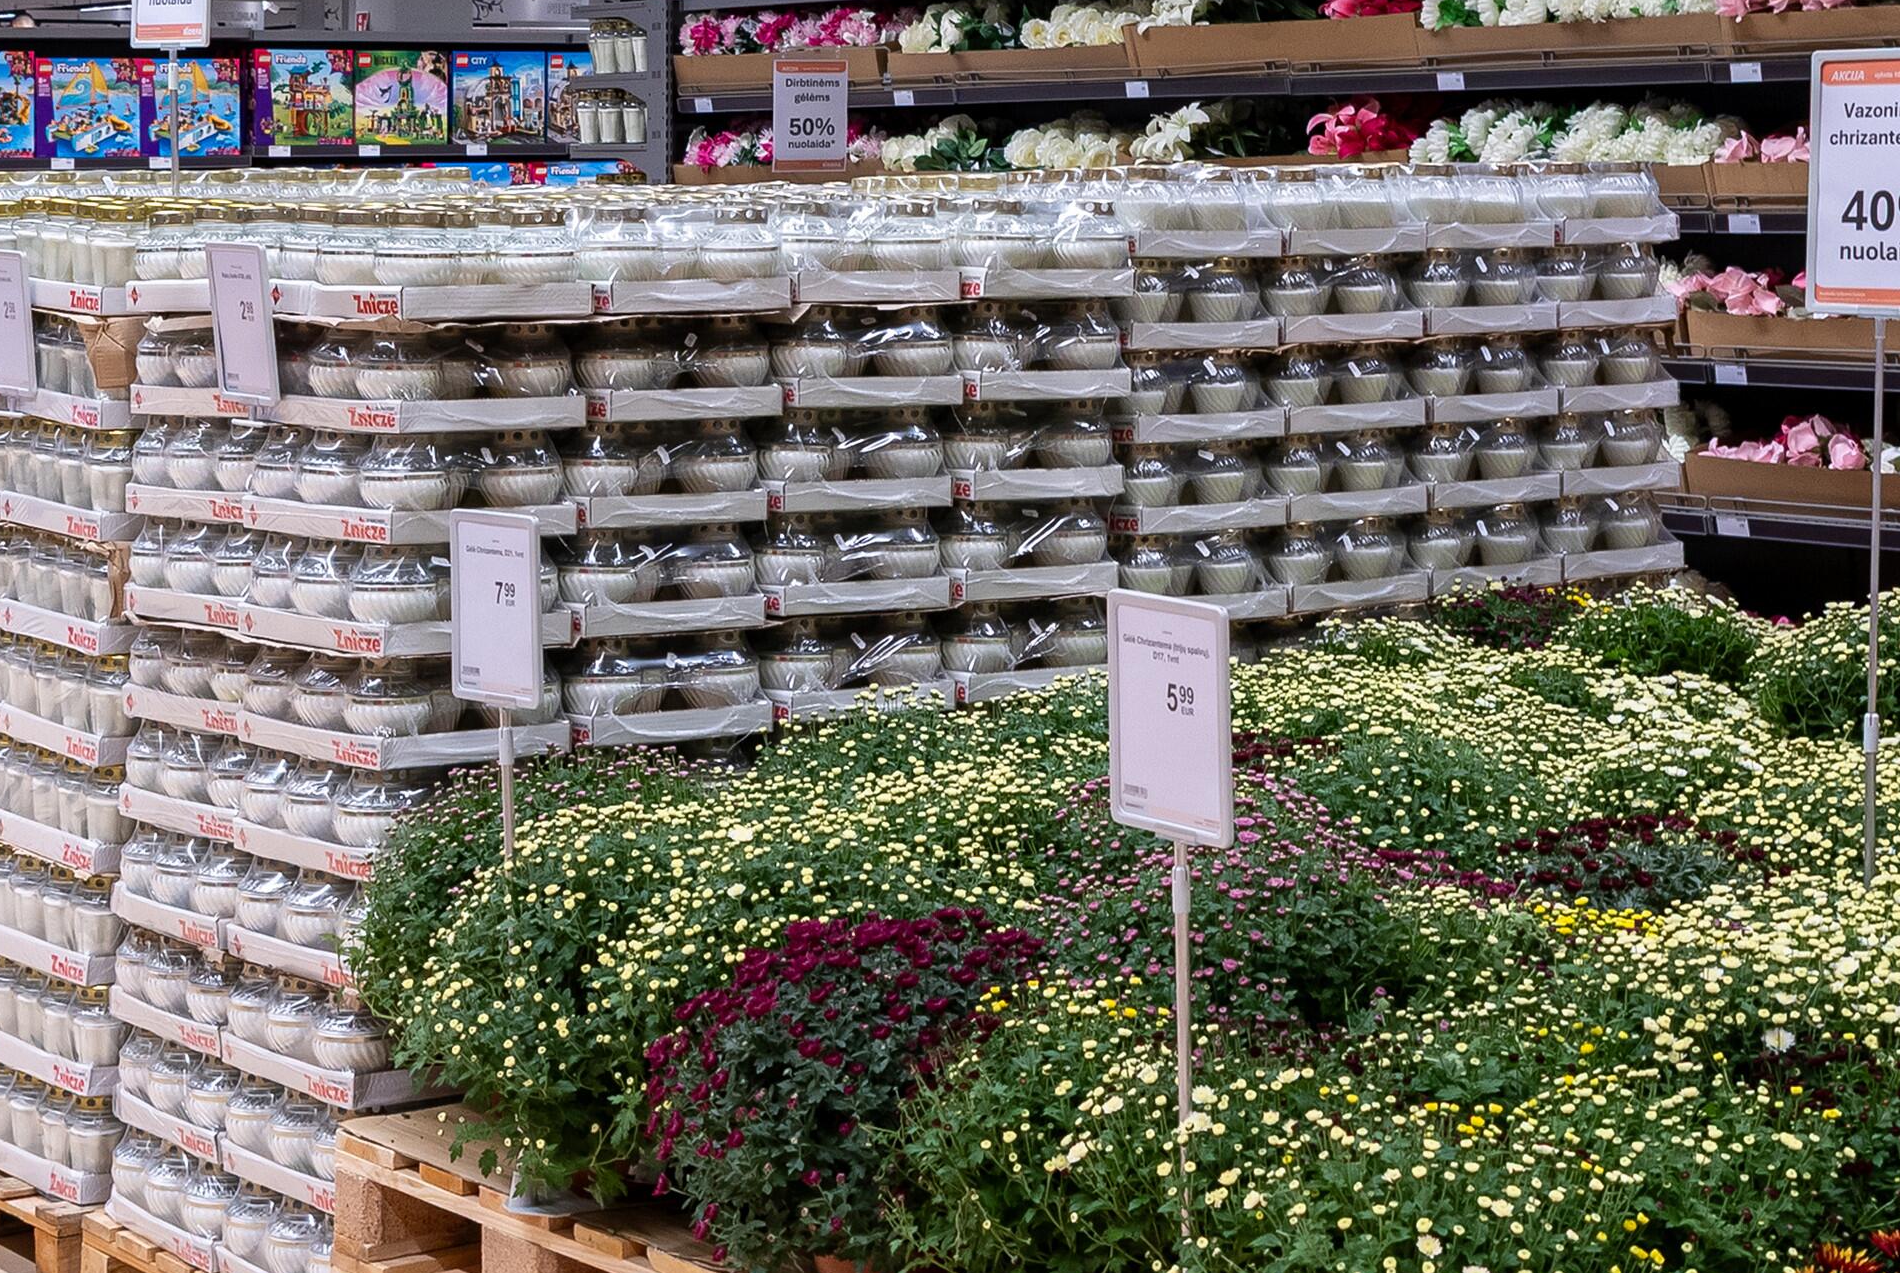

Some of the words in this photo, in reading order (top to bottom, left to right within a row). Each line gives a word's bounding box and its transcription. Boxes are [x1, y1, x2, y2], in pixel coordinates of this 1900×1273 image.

[56, 62, 91, 74] Friends
[275, 53, 308, 65] Friends
[471, 56, 488, 65] CITY
[785, 78, 840, 88] Dirbtinėms
[1831, 70, 1866, 81] AKCIJA
[794, 92, 830, 104] gėlėms
[789, 117, 836, 137] 50%
[550, 165, 580, 176] Friends
[70, 290, 99, 311] Znicze
[352, 294, 398, 315] Znicze
[349, 407, 395, 428] Znicze
[211, 499, 243, 520] Znicz
[68, 516, 97, 539] Znicze
[342, 519, 386, 540] Znicze
[495, 581, 504, 604] 7
[503, 582, 516, 598] 99
[205, 605, 239, 627] Znicz
[68, 626, 97, 651] Znicze
[335, 630, 381, 652] Znicze
[1167, 682, 1179, 712] 5
[1179, 685, 1195, 705] 99
[1180, 706, 1195, 717] EUR
[63, 844, 90, 870] Znicze
[52, 954, 83, 982] Znicze
[54, 1067, 84, 1092] Znicze
